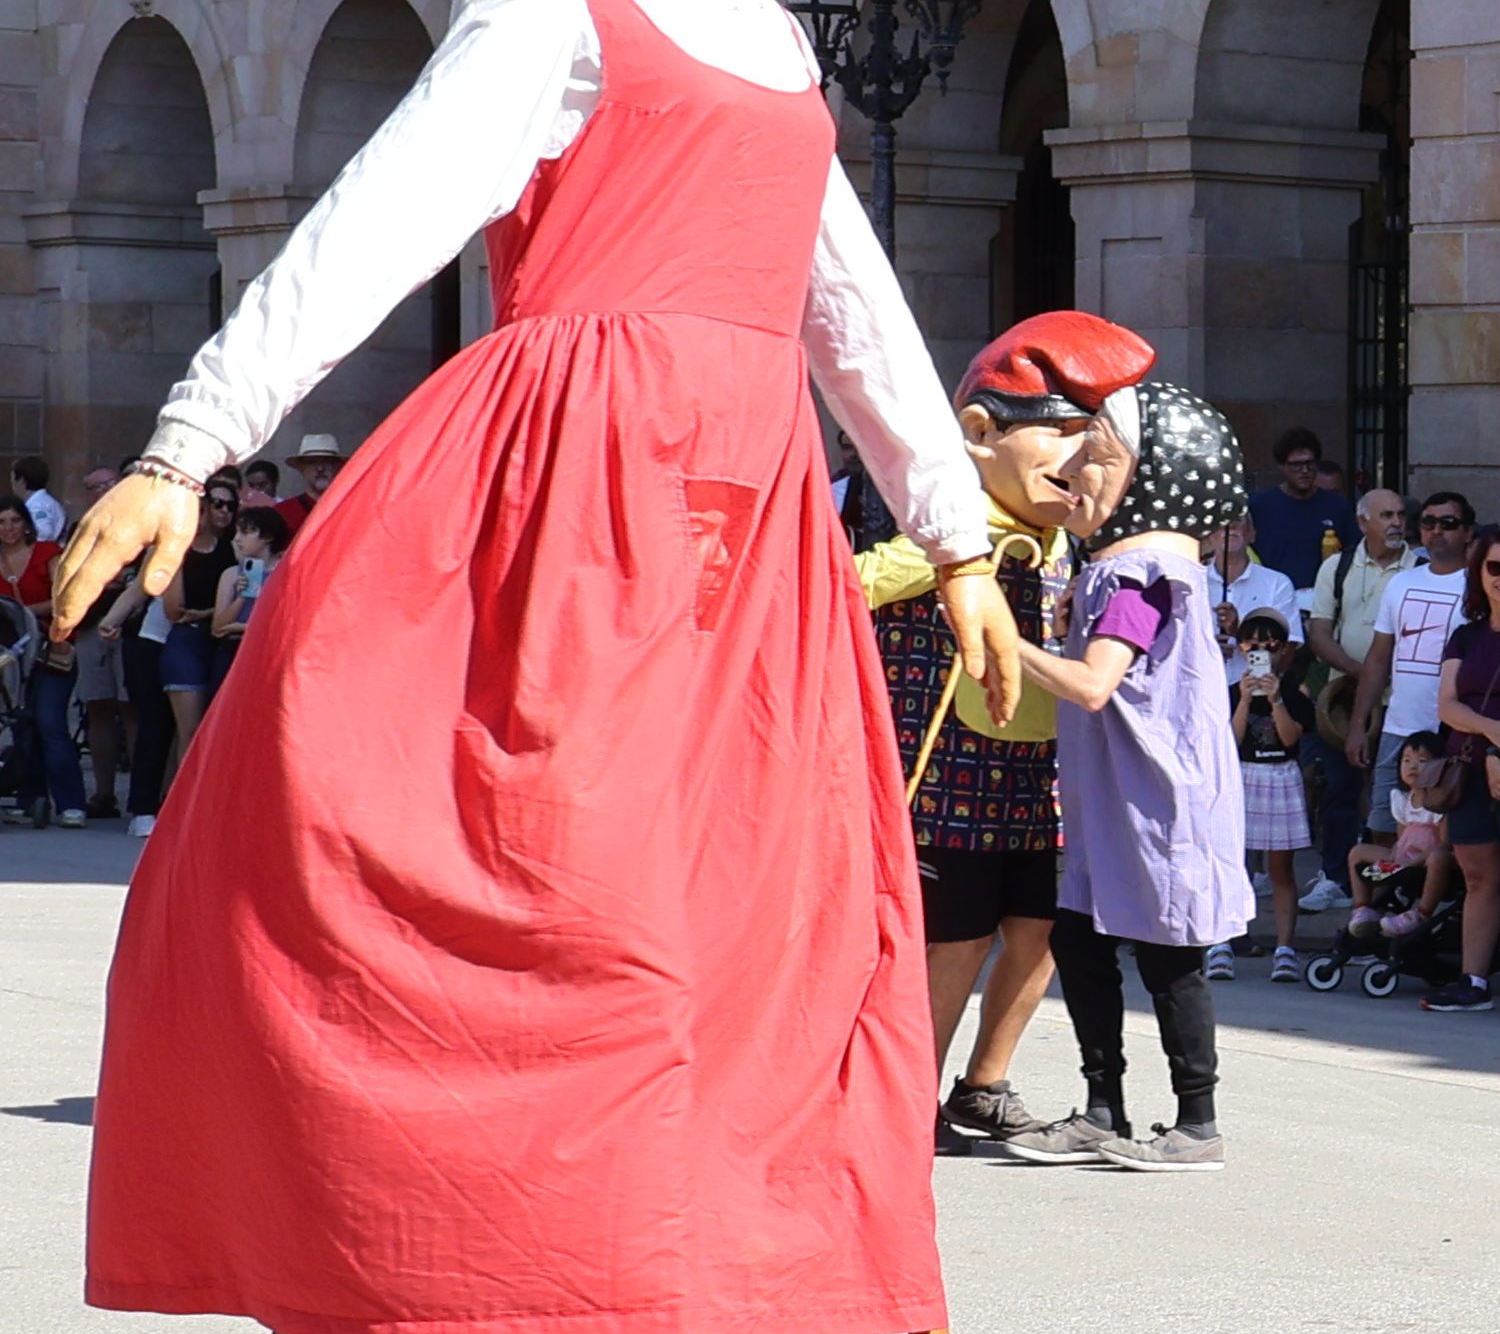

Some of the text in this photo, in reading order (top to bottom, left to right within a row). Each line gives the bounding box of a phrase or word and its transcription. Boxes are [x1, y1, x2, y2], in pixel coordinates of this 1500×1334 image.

[913, 636, 926, 648] D
[905, 698, 916, 711] D
[986, 803, 998, 818] C
[1009, 836, 1020, 849] D
